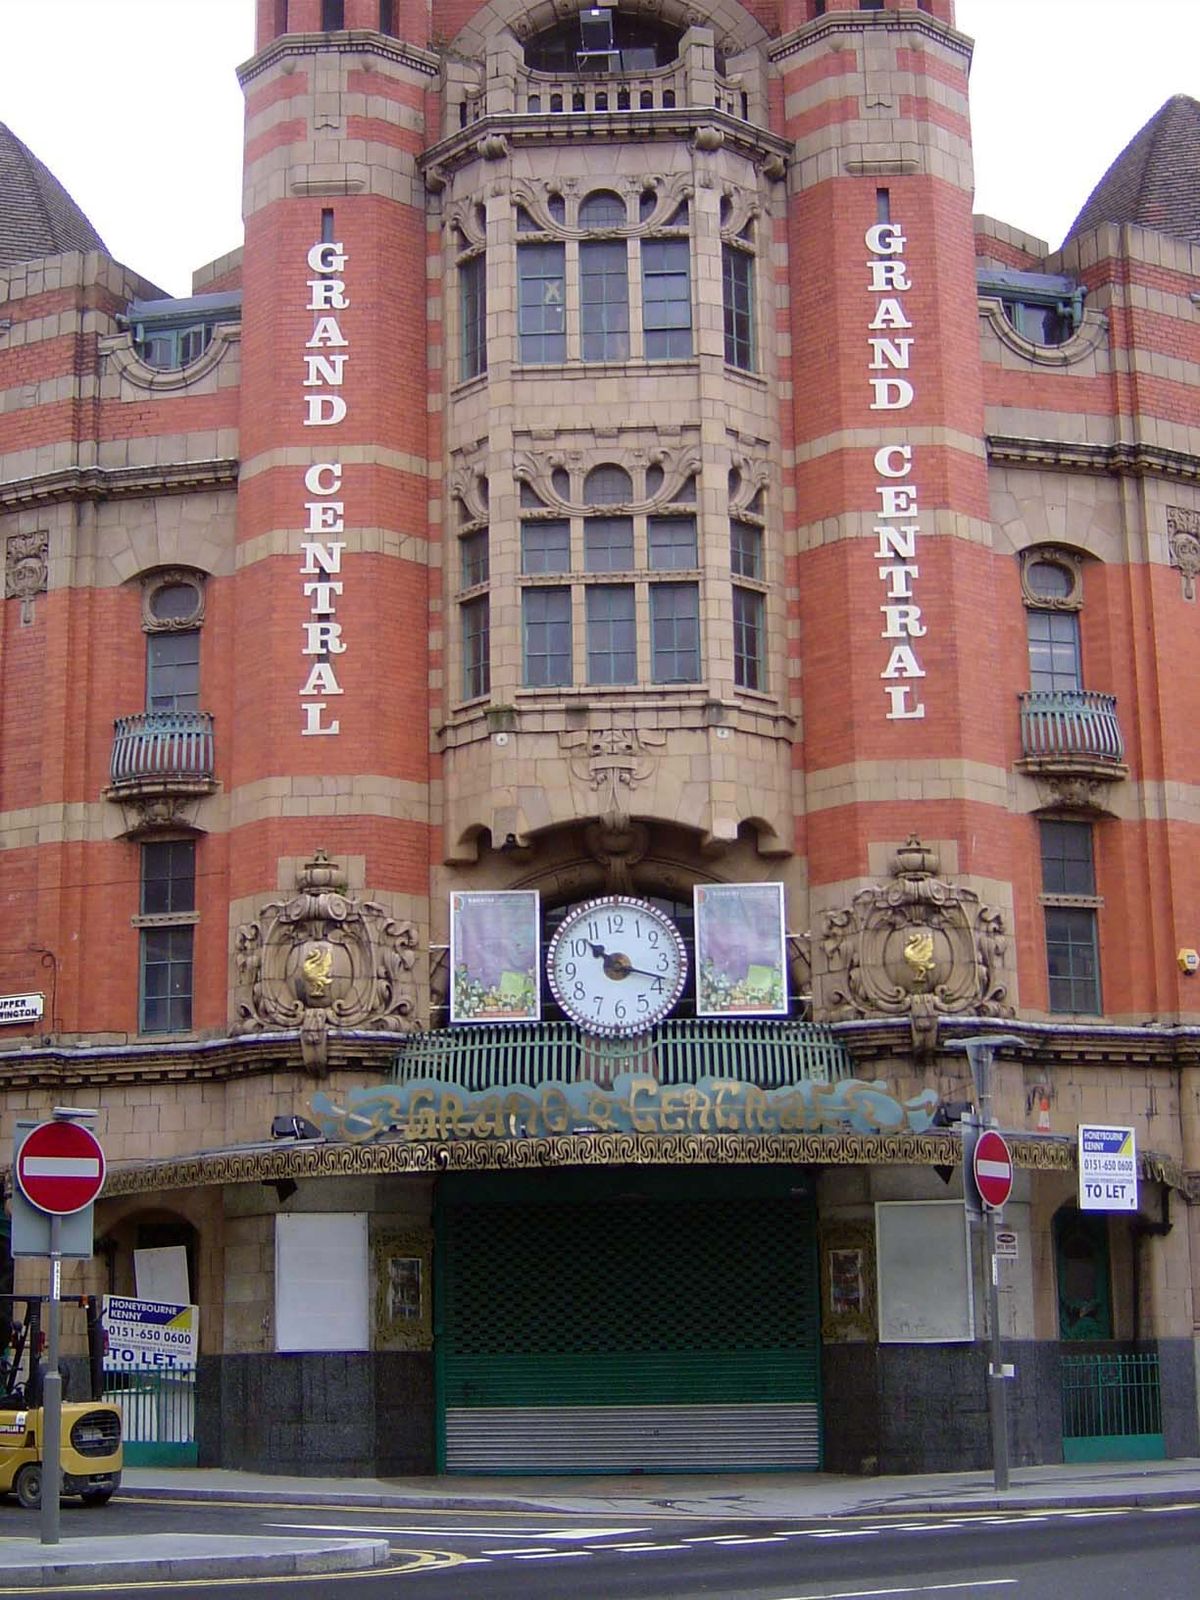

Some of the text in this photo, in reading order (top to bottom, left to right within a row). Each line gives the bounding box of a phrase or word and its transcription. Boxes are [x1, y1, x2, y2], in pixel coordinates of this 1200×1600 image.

[866, 224, 927, 719] GRAND CENTRAL
[299, 242, 349, 736] GRAND CENTRAL
[588, 921, 600, 941] 11
[606, 914, 624, 934] 12
[635, 919, 641, 939] 1
[570, 939, 588, 957] 10
[648, 930, 659, 949] 2
[565, 962, 577, 981] 9
[656, 953, 669, 972] 3
[573, 981, 586, 1000] 8
[650, 976, 665, 995] 4
[593, 996, 604, 1016] 7
[614, 1000, 627, 1019] 6
[636, 994, 649, 1014] 5
[1085, 1184, 1126, 1199] TO LET
[110, 1309, 142, 1321] KENNY
[111, 1299, 178, 1315] HONEYBOURNE
[109, 1325, 160, 1341] 0151-650
[163, 1331, 191, 1345] 0600
[109, 1347, 135, 1362] TO
[141, 1351, 177, 1367] LET
